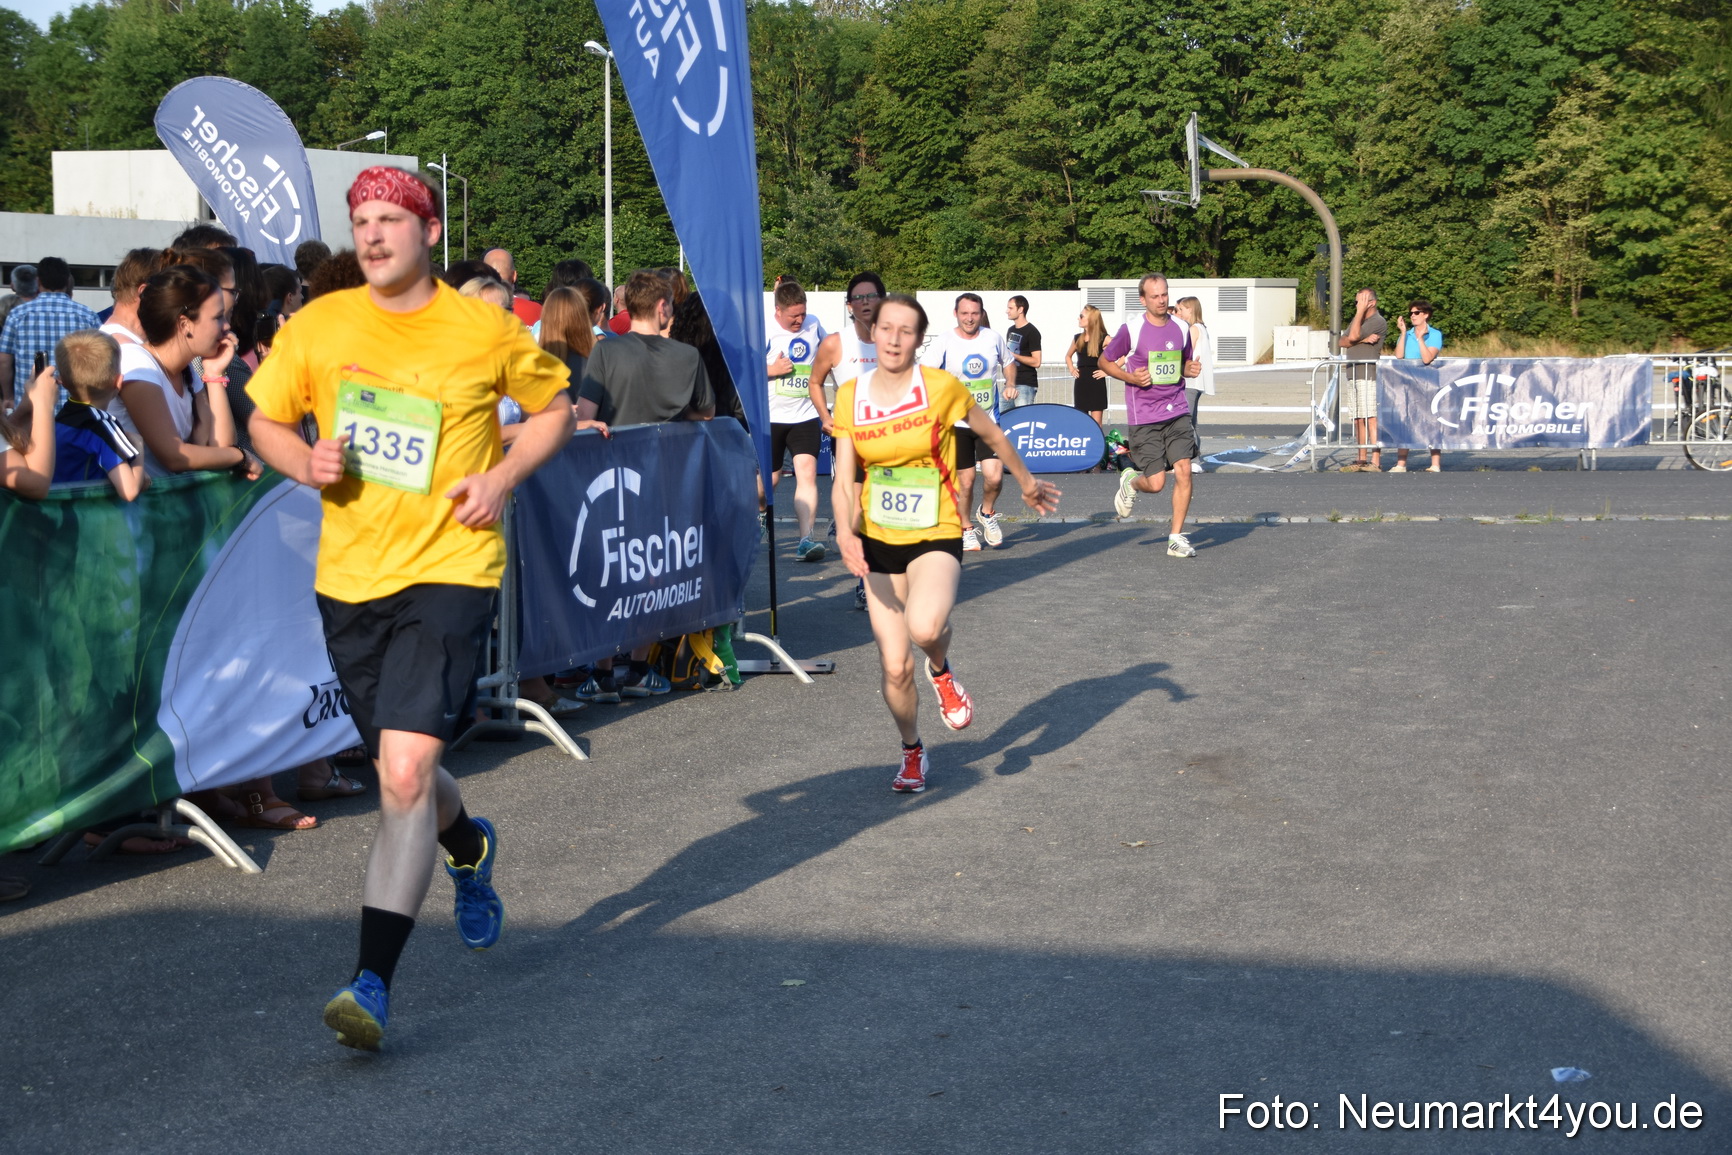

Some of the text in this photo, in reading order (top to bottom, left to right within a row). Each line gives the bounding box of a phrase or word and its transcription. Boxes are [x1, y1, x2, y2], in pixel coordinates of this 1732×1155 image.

[1155, 364, 1176, 375] 503
[780, 377, 808, 389] 1486
[1459, 395, 1594, 421] Fischer
[854, 427, 888, 442] MAX
[892, 414, 932, 435] BÖGL
[1471, 423, 1583, 435] AUTOMOBILE
[344, 421, 425, 466] 1335
[1017, 433, 1091, 450] Fischer
[1025, 449, 1087, 458] AUTOMOBILE
[881, 490, 923, 514] 887
[606, 576, 703, 622] AUTOMOBILE
